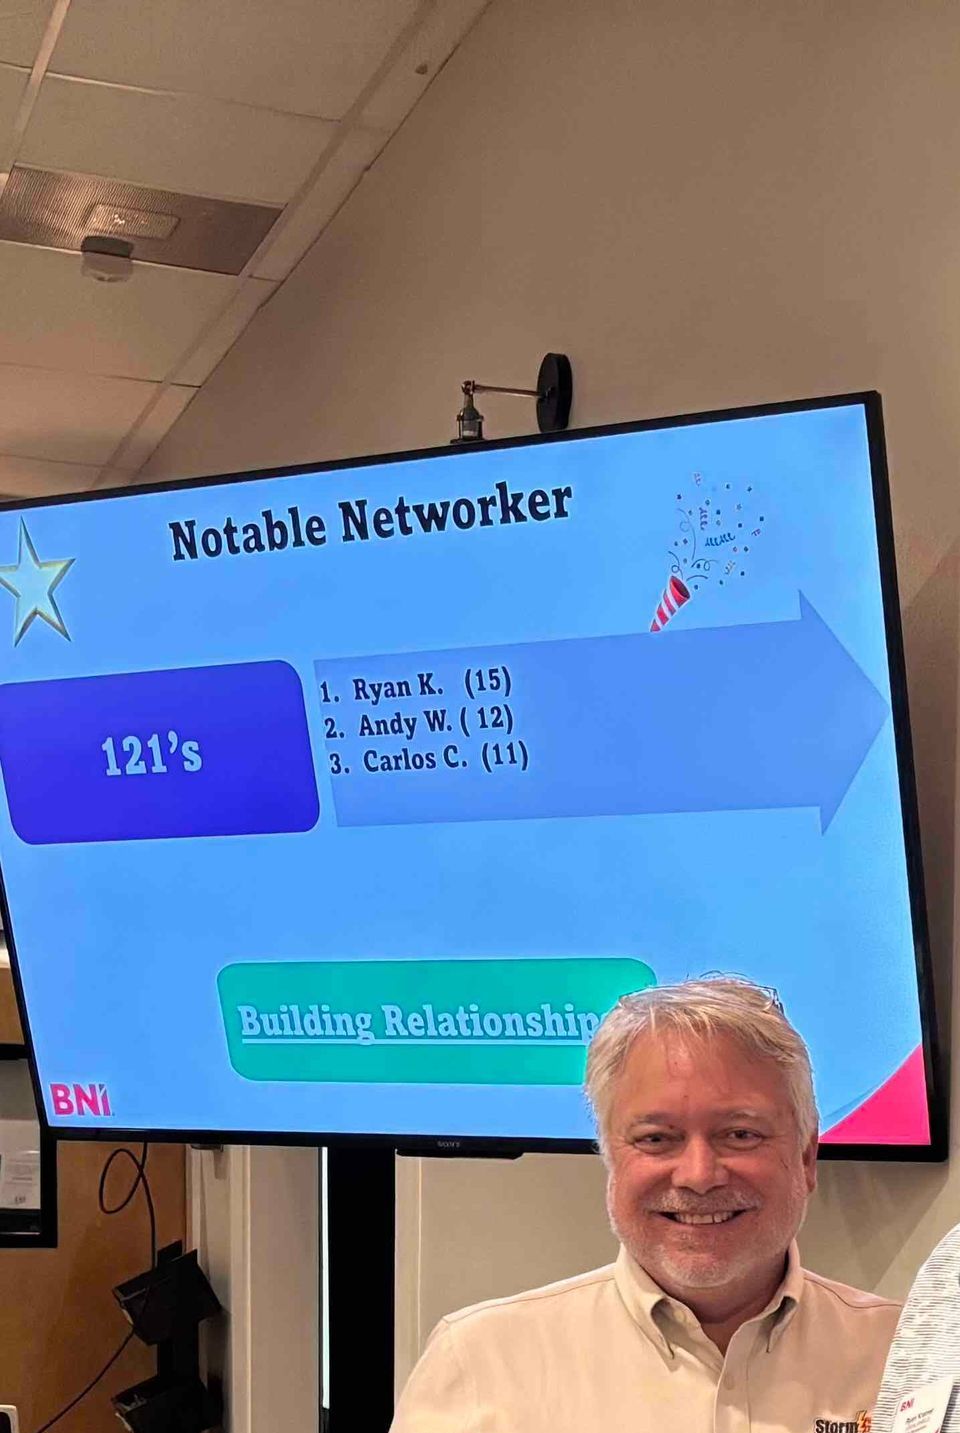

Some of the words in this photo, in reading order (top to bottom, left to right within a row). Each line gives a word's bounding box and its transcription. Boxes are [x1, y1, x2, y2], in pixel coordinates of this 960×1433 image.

[169, 505, 326, 561] Notable
[338, 481, 572, 542] Networker
[320, 681, 340, 703] 1.
[353, 678, 412, 705] Ryan
[417, 673, 443, 695] K.
[465, 666, 511, 699] (15)
[324, 717, 344, 738] 2.
[359, 712, 417, 740] Andy
[423, 709, 452, 732] W.
[101, 730, 202, 776] 121's
[330, 753, 350, 774] 3.
[364, 748, 437, 772] Carlos
[443, 744, 467, 768] C.
[482, 740, 528, 773] (11)
[237, 1004, 376, 1044] Building
[381, 1003, 603, 1043] Relationship
[50, 1084, 111, 1116] BNI
